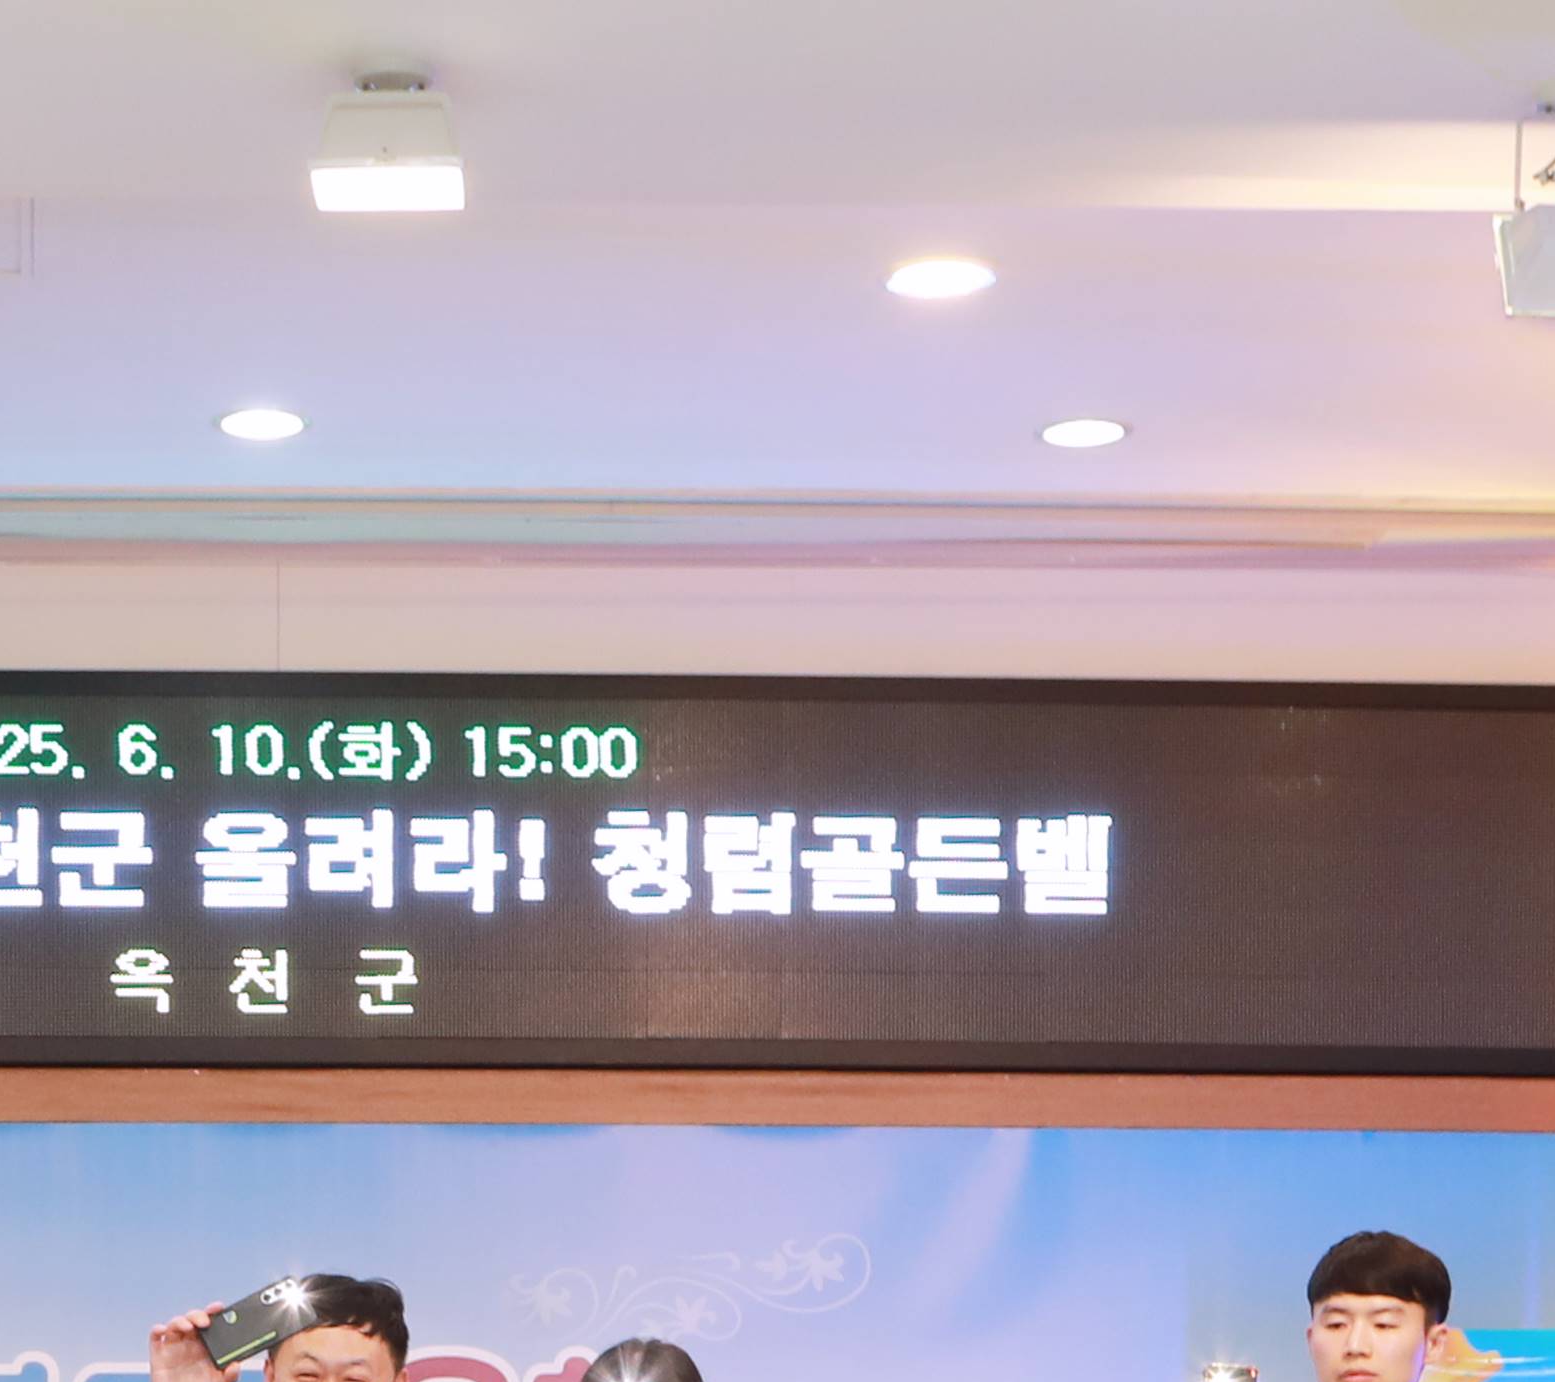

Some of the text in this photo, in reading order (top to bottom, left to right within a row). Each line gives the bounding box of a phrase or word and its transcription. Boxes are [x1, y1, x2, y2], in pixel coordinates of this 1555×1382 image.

[118, 724, 175, 781] 6.
[212, 721, 432, 781] 10.(화)
[464, 725, 638, 780] 15:00
[194, 808, 546, 913] 울려라!
[591, 810, 1113, 915] 청렴골든벨
